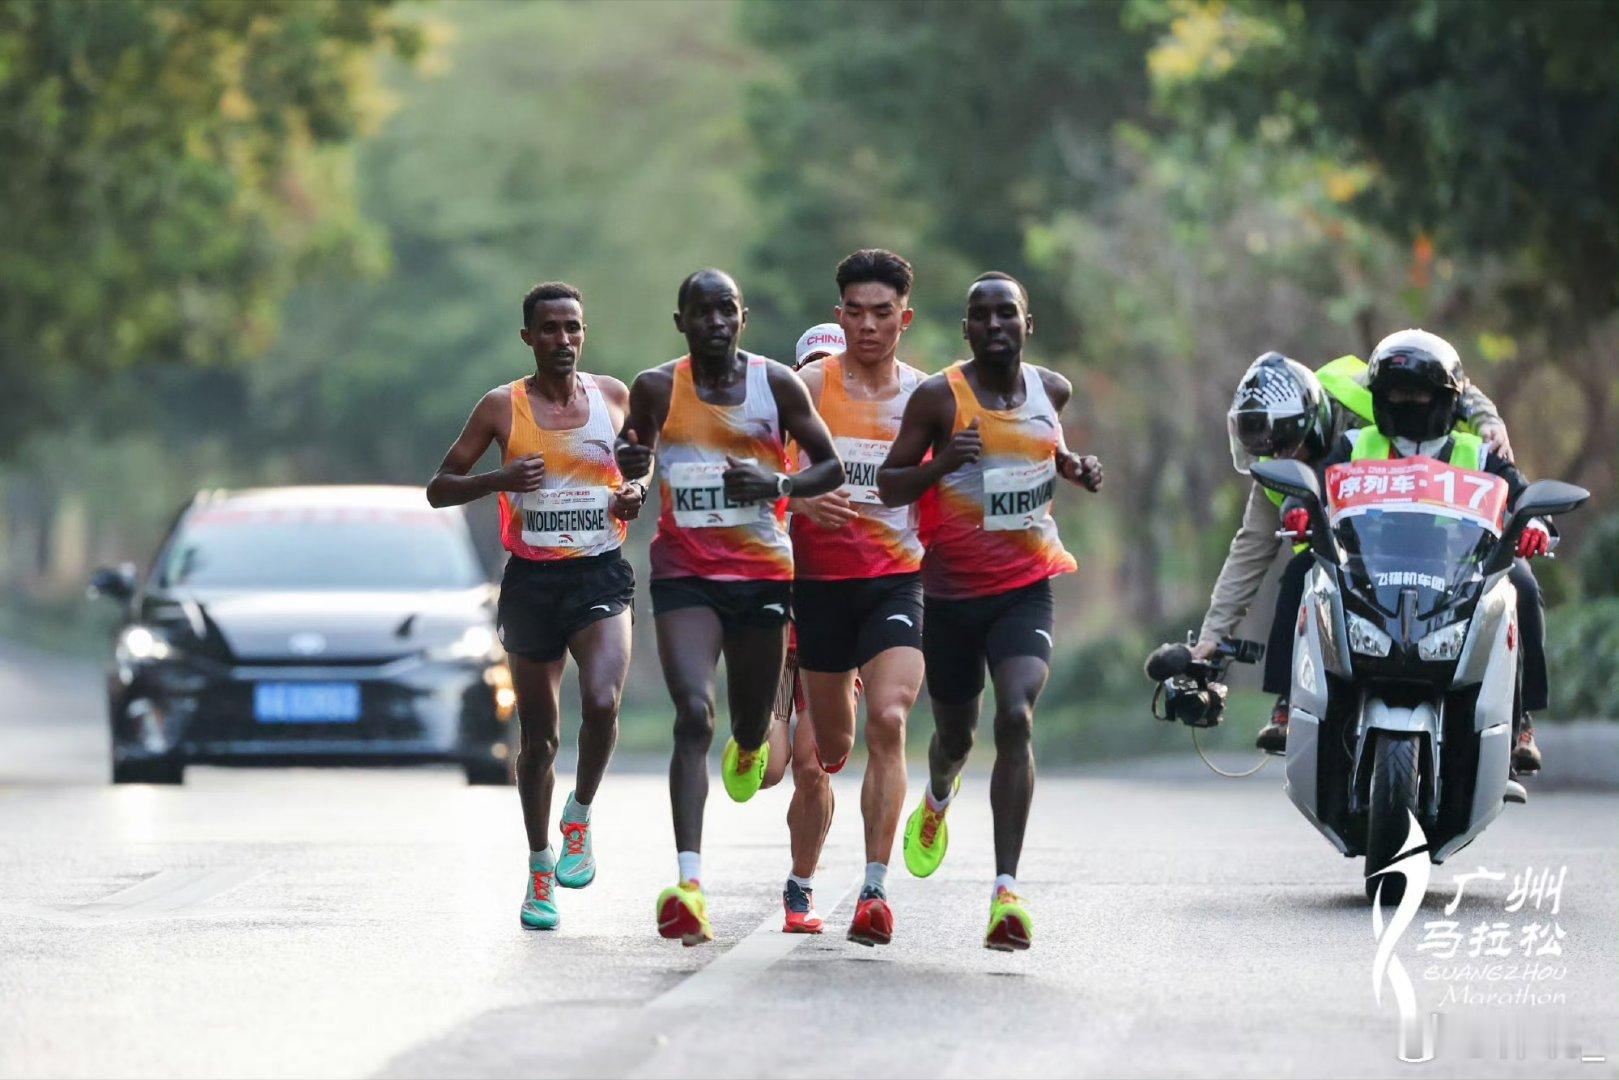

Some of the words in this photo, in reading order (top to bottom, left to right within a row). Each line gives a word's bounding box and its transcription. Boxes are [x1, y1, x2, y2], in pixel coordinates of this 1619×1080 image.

[806, 334, 845, 346] CHINA
[843, 461, 875, 486] HAXI
[526, 509, 604, 532] WOLDETENSAE
